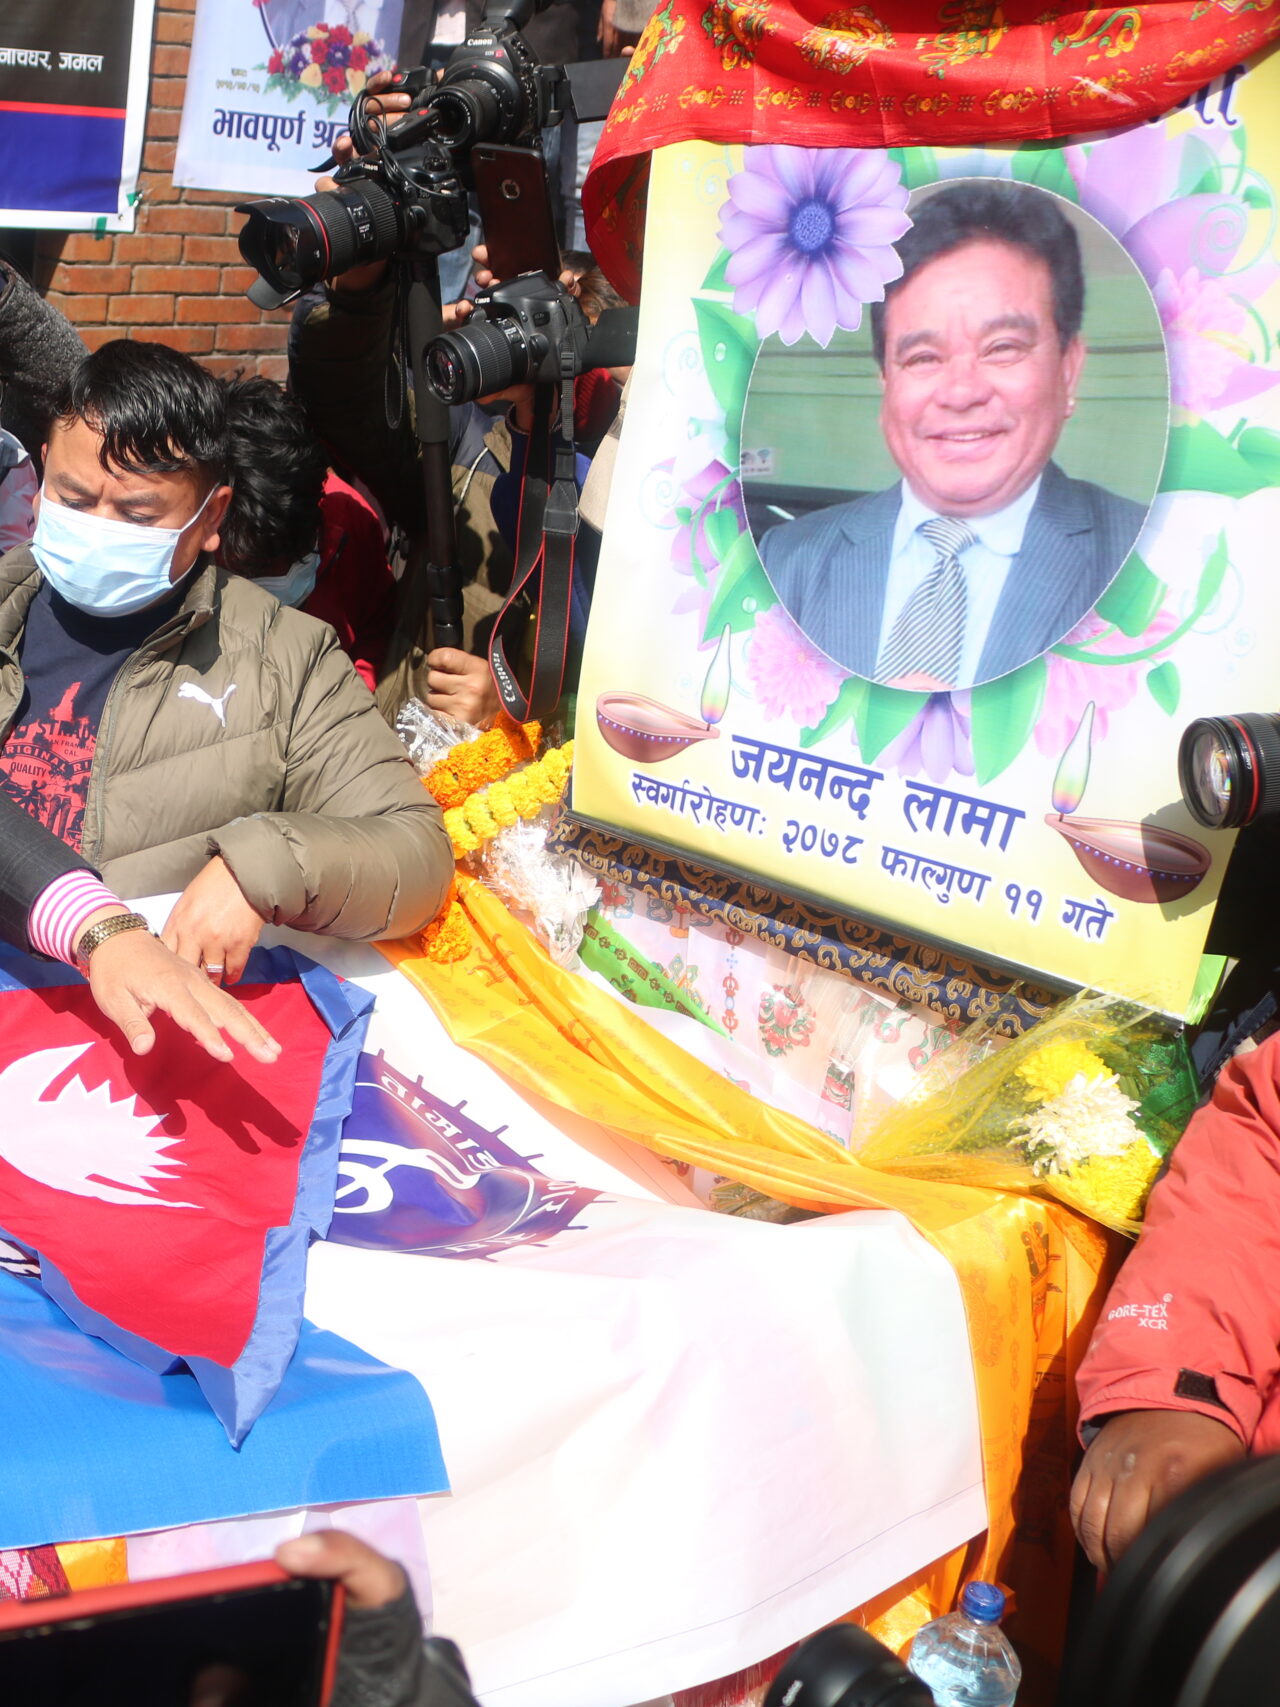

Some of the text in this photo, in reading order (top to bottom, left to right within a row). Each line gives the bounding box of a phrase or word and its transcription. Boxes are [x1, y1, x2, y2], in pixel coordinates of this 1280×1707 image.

[467, 38, 493, 47] Canon
[58, 52, 104, 72] जमल
[213, 108, 306, 152] भावपूर्ण
[10, 761, 47, 777] QUALITY
[731, 734, 1026, 852] जयनन्द लामा
[631, 773, 1114, 939] स्वर्गारोहण: २०७८ फाल्गुण ११ गते
[1107, 1302, 1169, 1321] GORE-TEX
[1137, 1317, 1169, 1331] XCR
